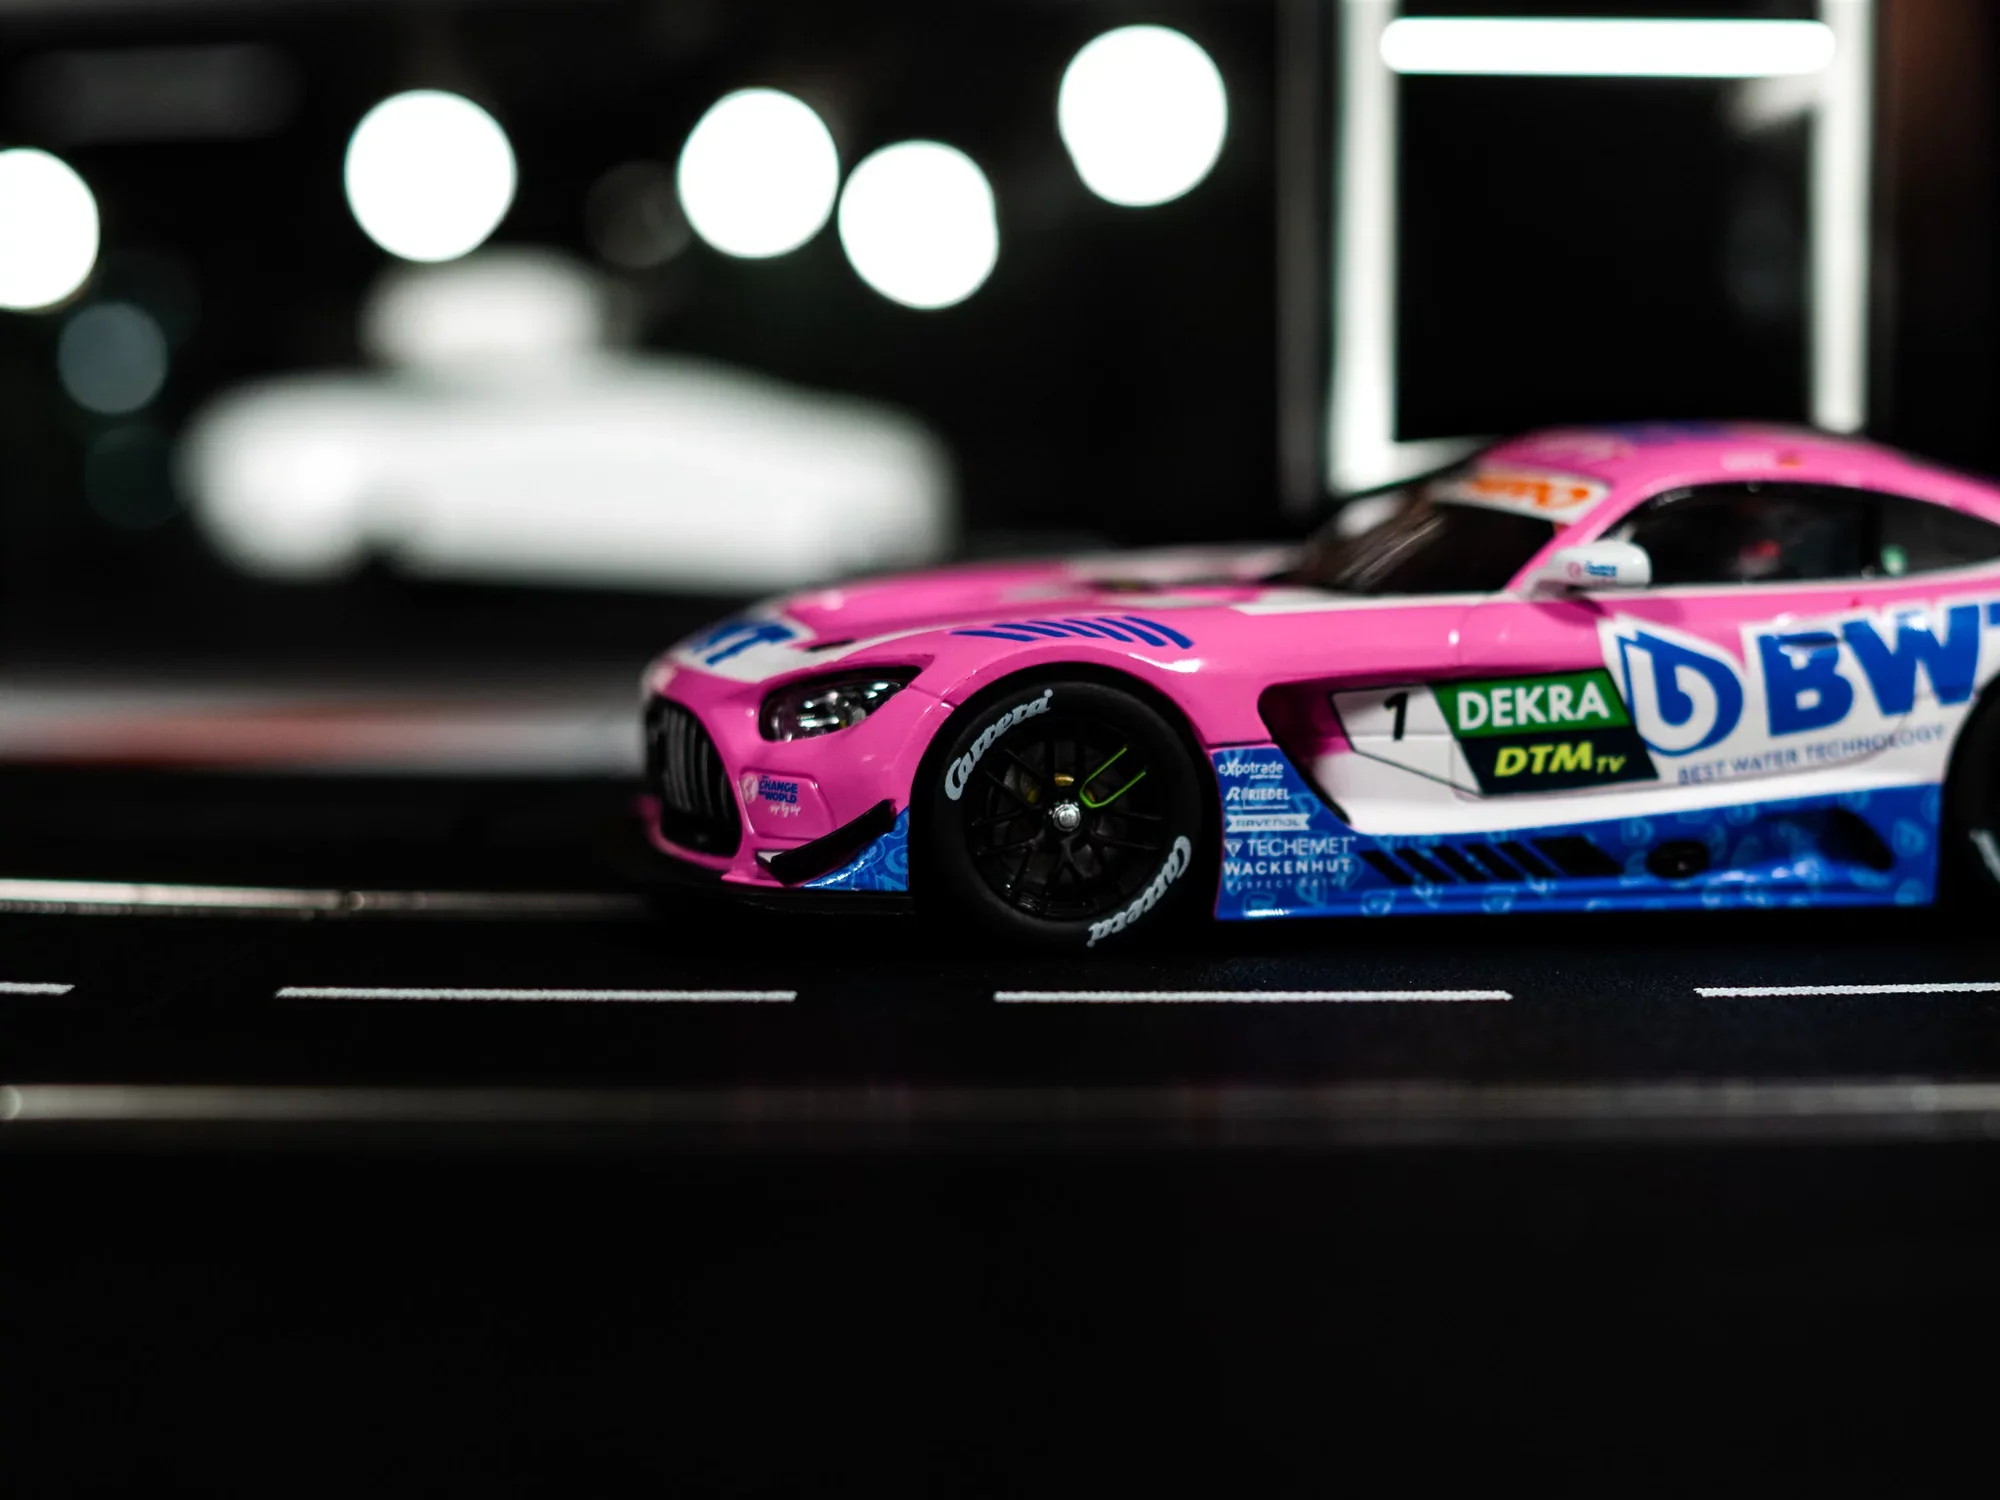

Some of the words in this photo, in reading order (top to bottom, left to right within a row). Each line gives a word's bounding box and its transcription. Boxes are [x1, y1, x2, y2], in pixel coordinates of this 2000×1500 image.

[1383, 692, 1409, 742] 1
[1457, 681, 1610, 730] DEKRA
[945, 689, 1053, 800] Carrera
[1494, 741, 1593, 777] DTM
[1597, 755, 1625, 774] TV
[1677, 760, 1725, 785] BEST
[1732, 748, 1797, 773] WATER
[1805, 724, 1944, 761] TECHNOLOGY
[759, 780, 798, 794] CHANGE
[766, 792, 797, 804] WORLD
[1224, 858, 1351, 876] WACKENHUT
[1247, 836, 1350, 857] TECHEMET
[1086, 836, 1191, 947] Carrera
